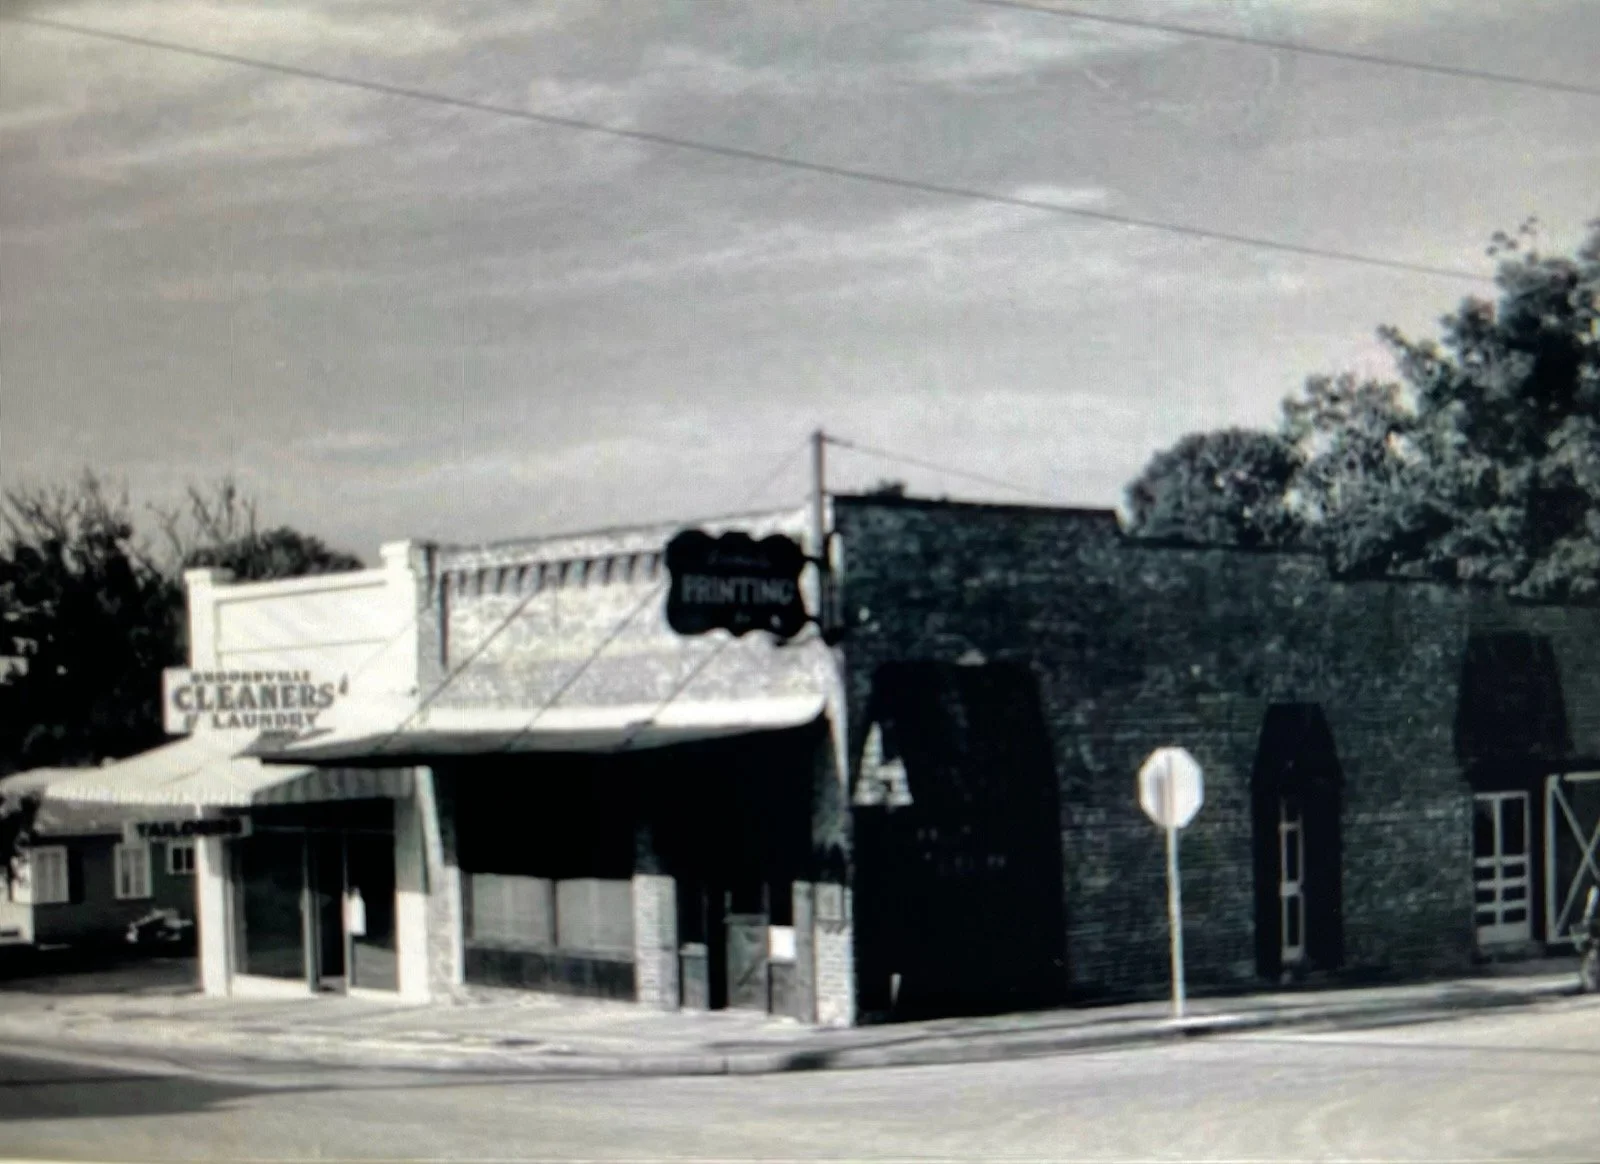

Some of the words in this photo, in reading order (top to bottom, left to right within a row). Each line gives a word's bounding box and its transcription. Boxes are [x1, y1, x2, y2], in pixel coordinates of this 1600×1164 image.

[680, 573, 795, 606] PRINTING
[173, 682, 335, 712] CLEANERS
[212, 711, 319, 729] LAUNDRY
